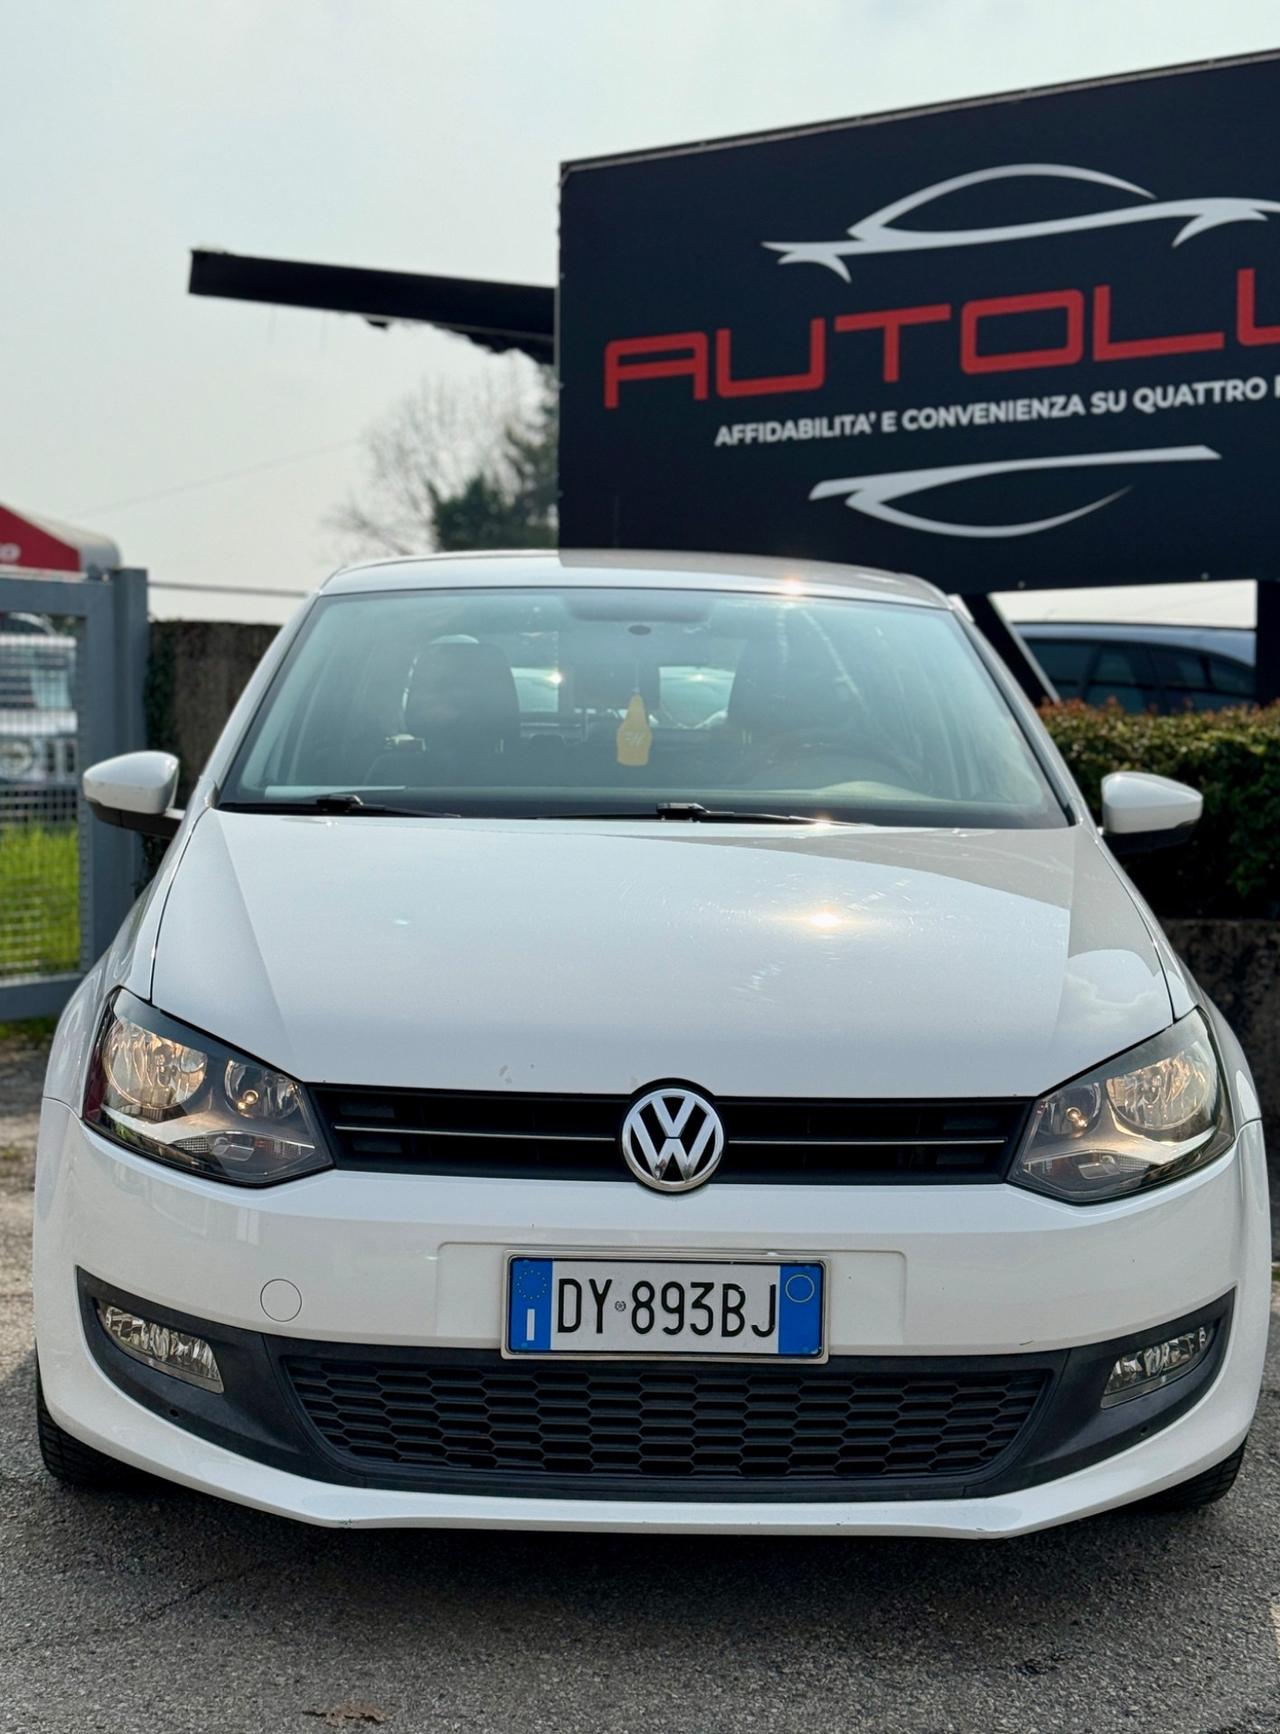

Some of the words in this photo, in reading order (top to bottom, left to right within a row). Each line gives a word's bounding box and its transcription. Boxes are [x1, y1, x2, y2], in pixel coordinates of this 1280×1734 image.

[715, 411, 877, 446] AFFIDABILITA'
[881, 410, 897, 433] E
[901, 394, 1086, 431] CONVENIENZA
[1090, 389, 1127, 415] SU
[1132, 376, 1268, 414] QUATTRO
